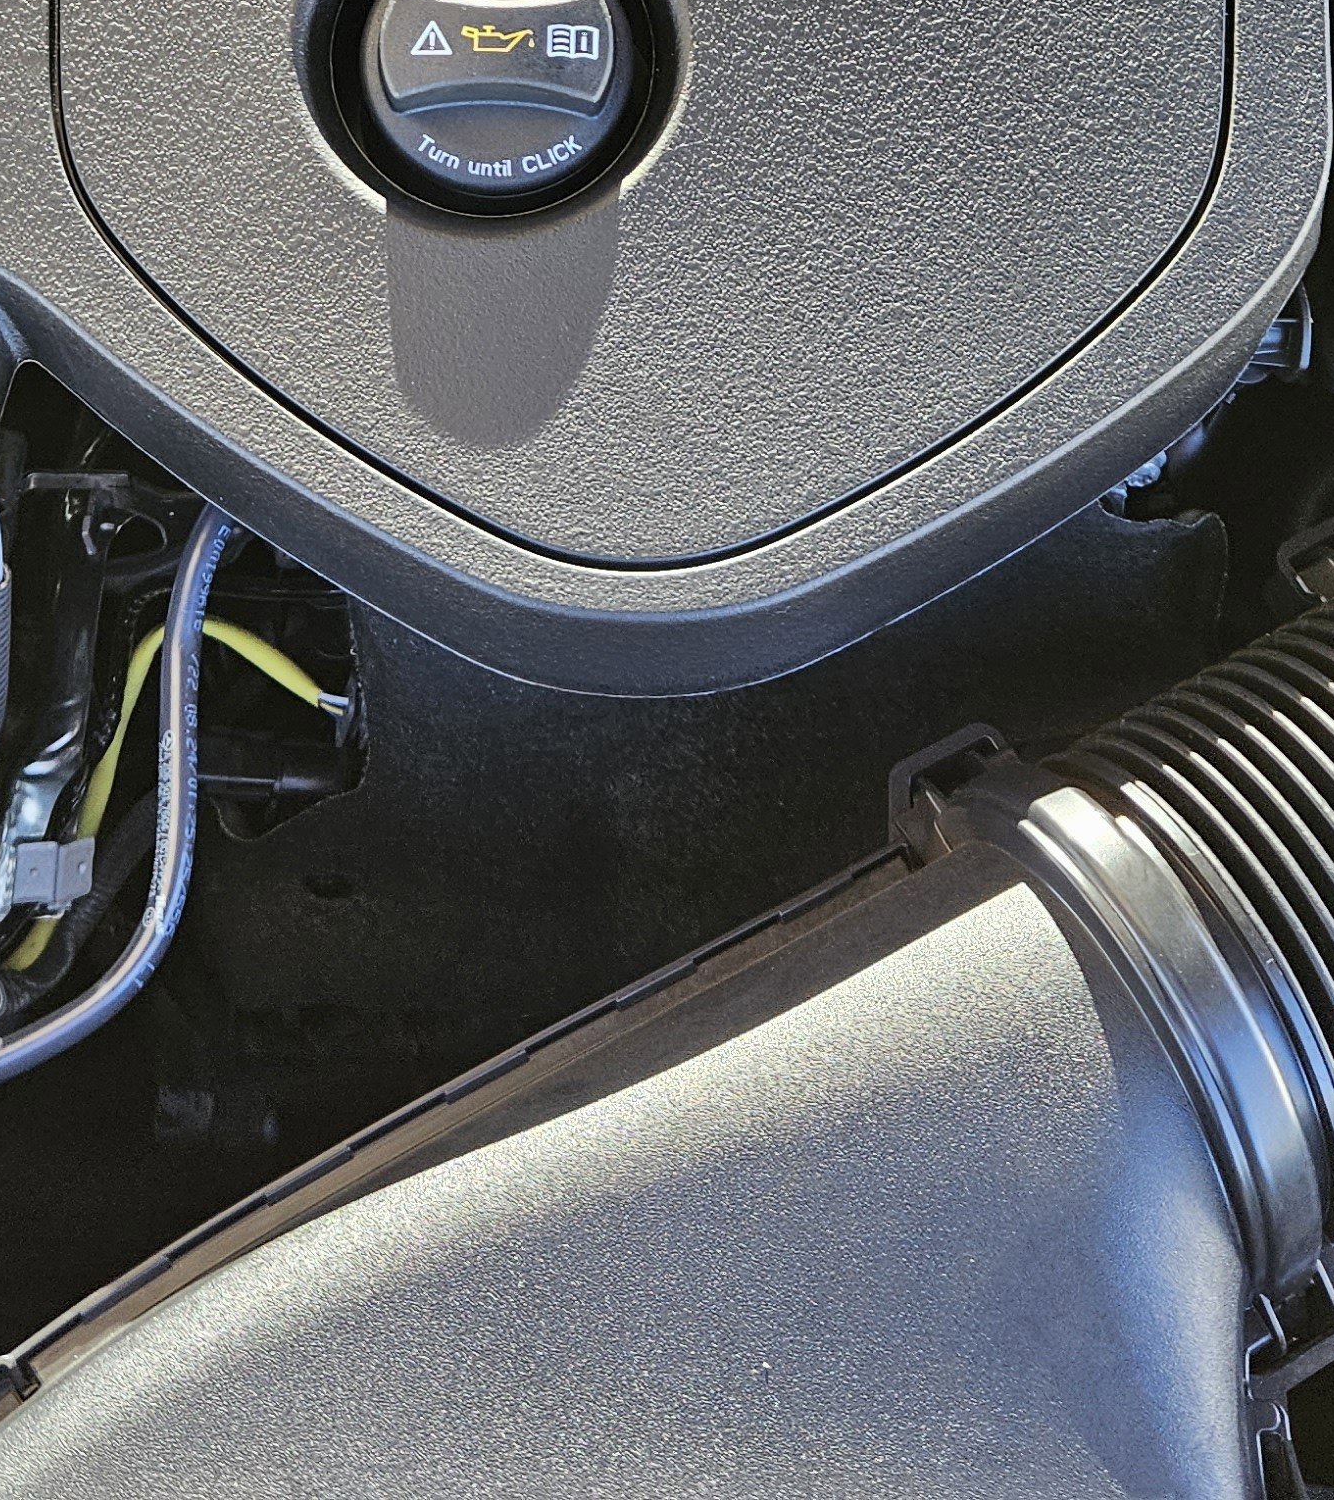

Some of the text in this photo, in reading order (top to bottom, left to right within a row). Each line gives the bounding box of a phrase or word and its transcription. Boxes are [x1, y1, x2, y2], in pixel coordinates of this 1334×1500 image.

[417, 134, 582, 177] Turn until CLICK
